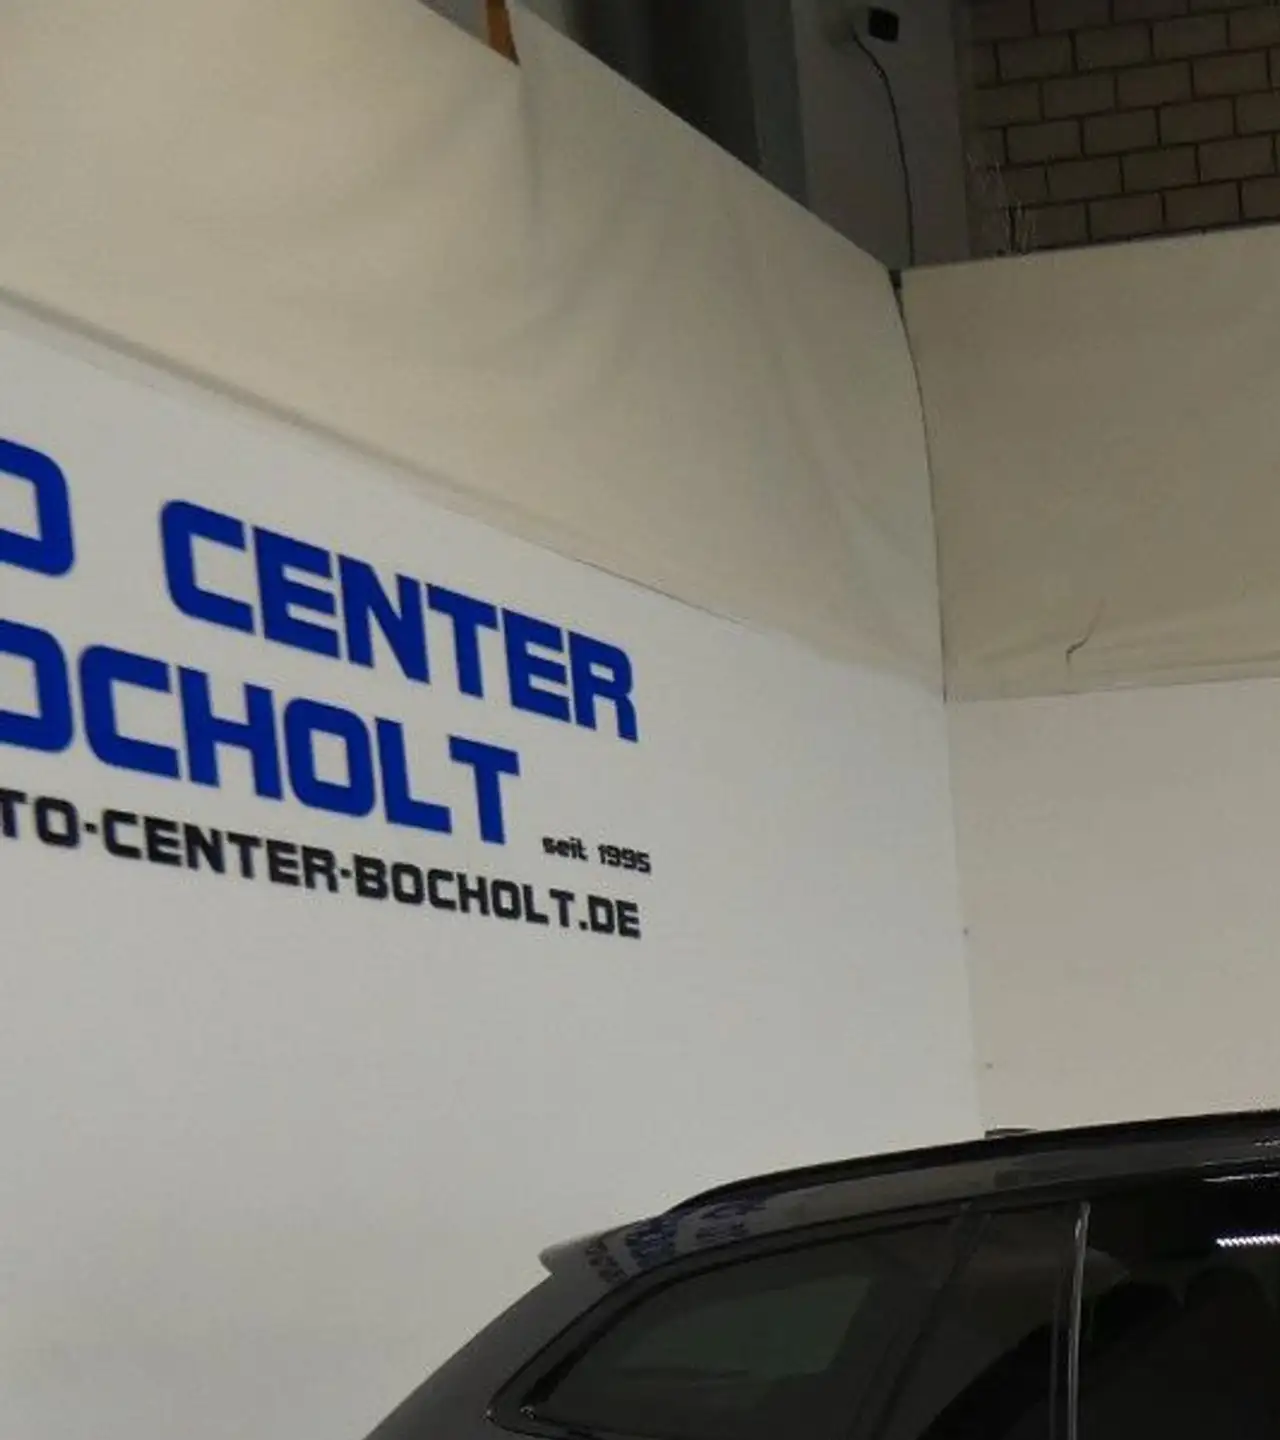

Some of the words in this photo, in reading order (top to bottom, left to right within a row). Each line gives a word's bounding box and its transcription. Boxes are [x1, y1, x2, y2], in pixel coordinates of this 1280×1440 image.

[160, 499, 639, 742] CENTER
[542, 836, 589, 862] seit
[597, 844, 652, 874] 1995
